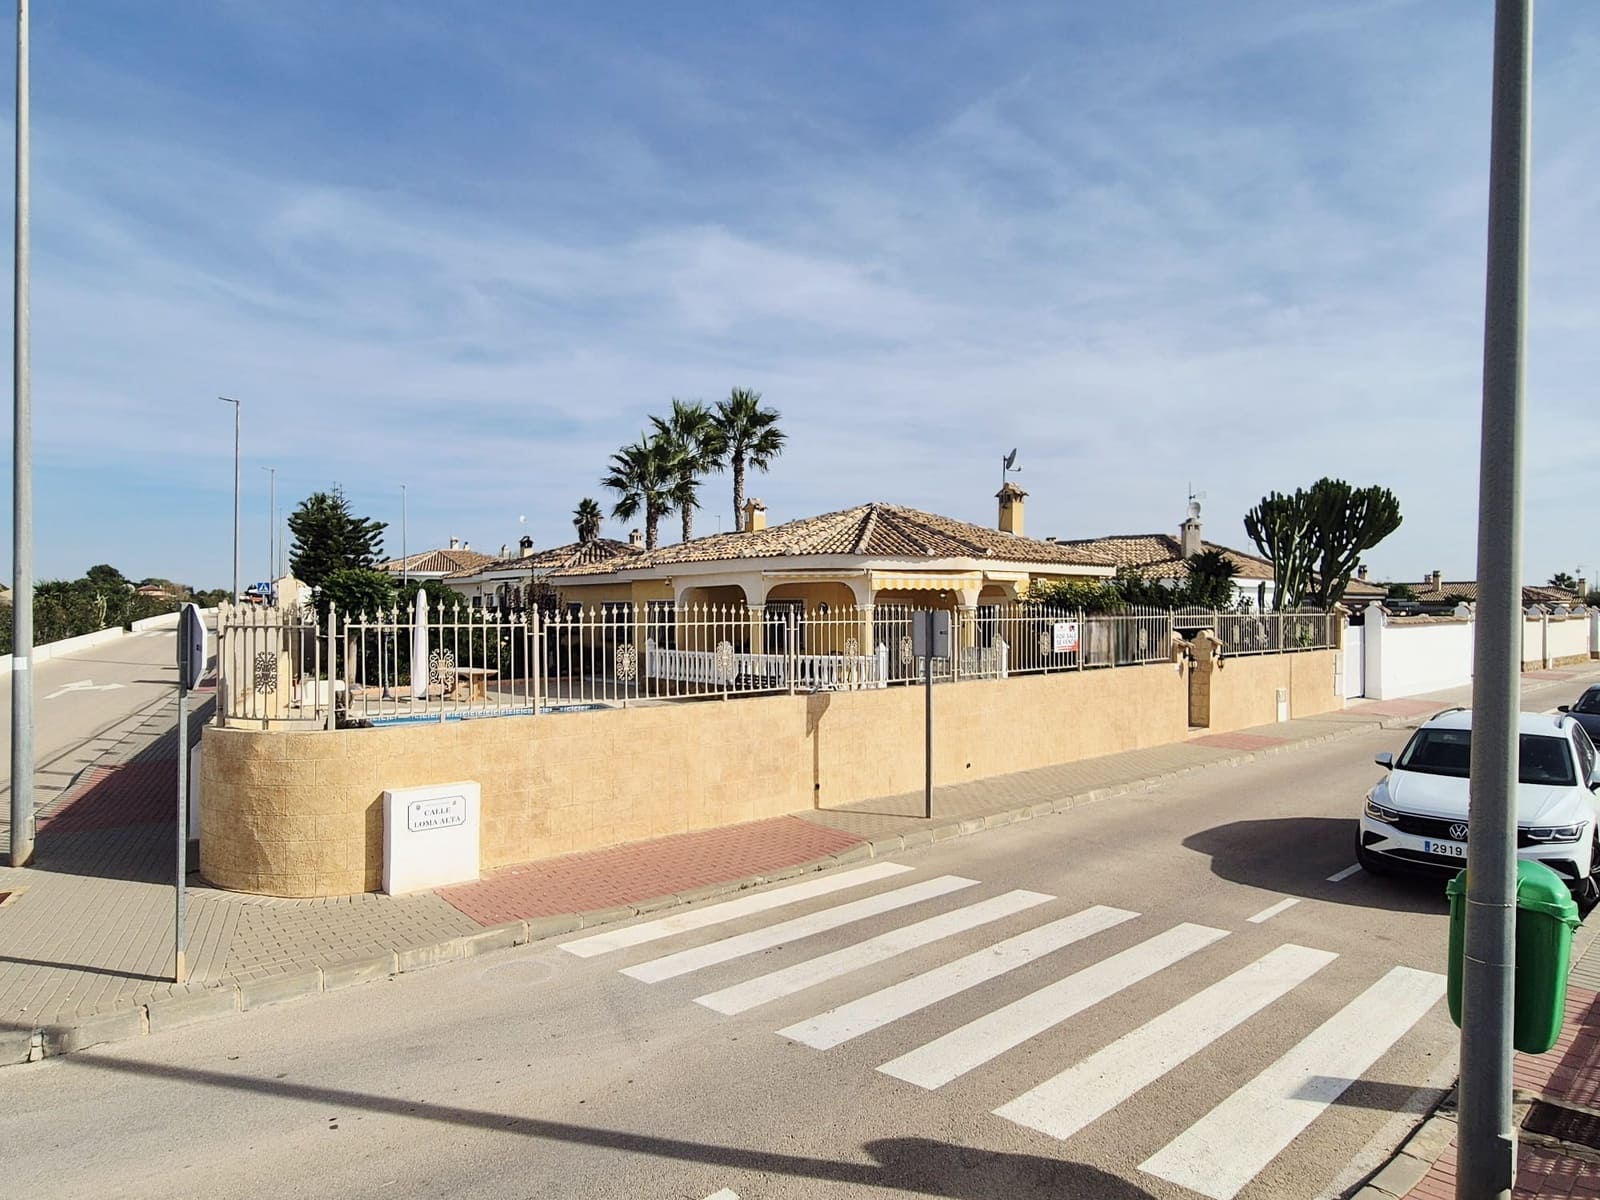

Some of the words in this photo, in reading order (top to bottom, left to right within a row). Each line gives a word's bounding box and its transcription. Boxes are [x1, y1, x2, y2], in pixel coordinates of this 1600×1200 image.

[424, 807, 450, 816] CALLE
[414, 818, 438, 828] LOMA
[440, 815, 461, 824] ALTA
[1450, 824, 1469, 839] VW
[1432, 843, 1463, 856] 2919
